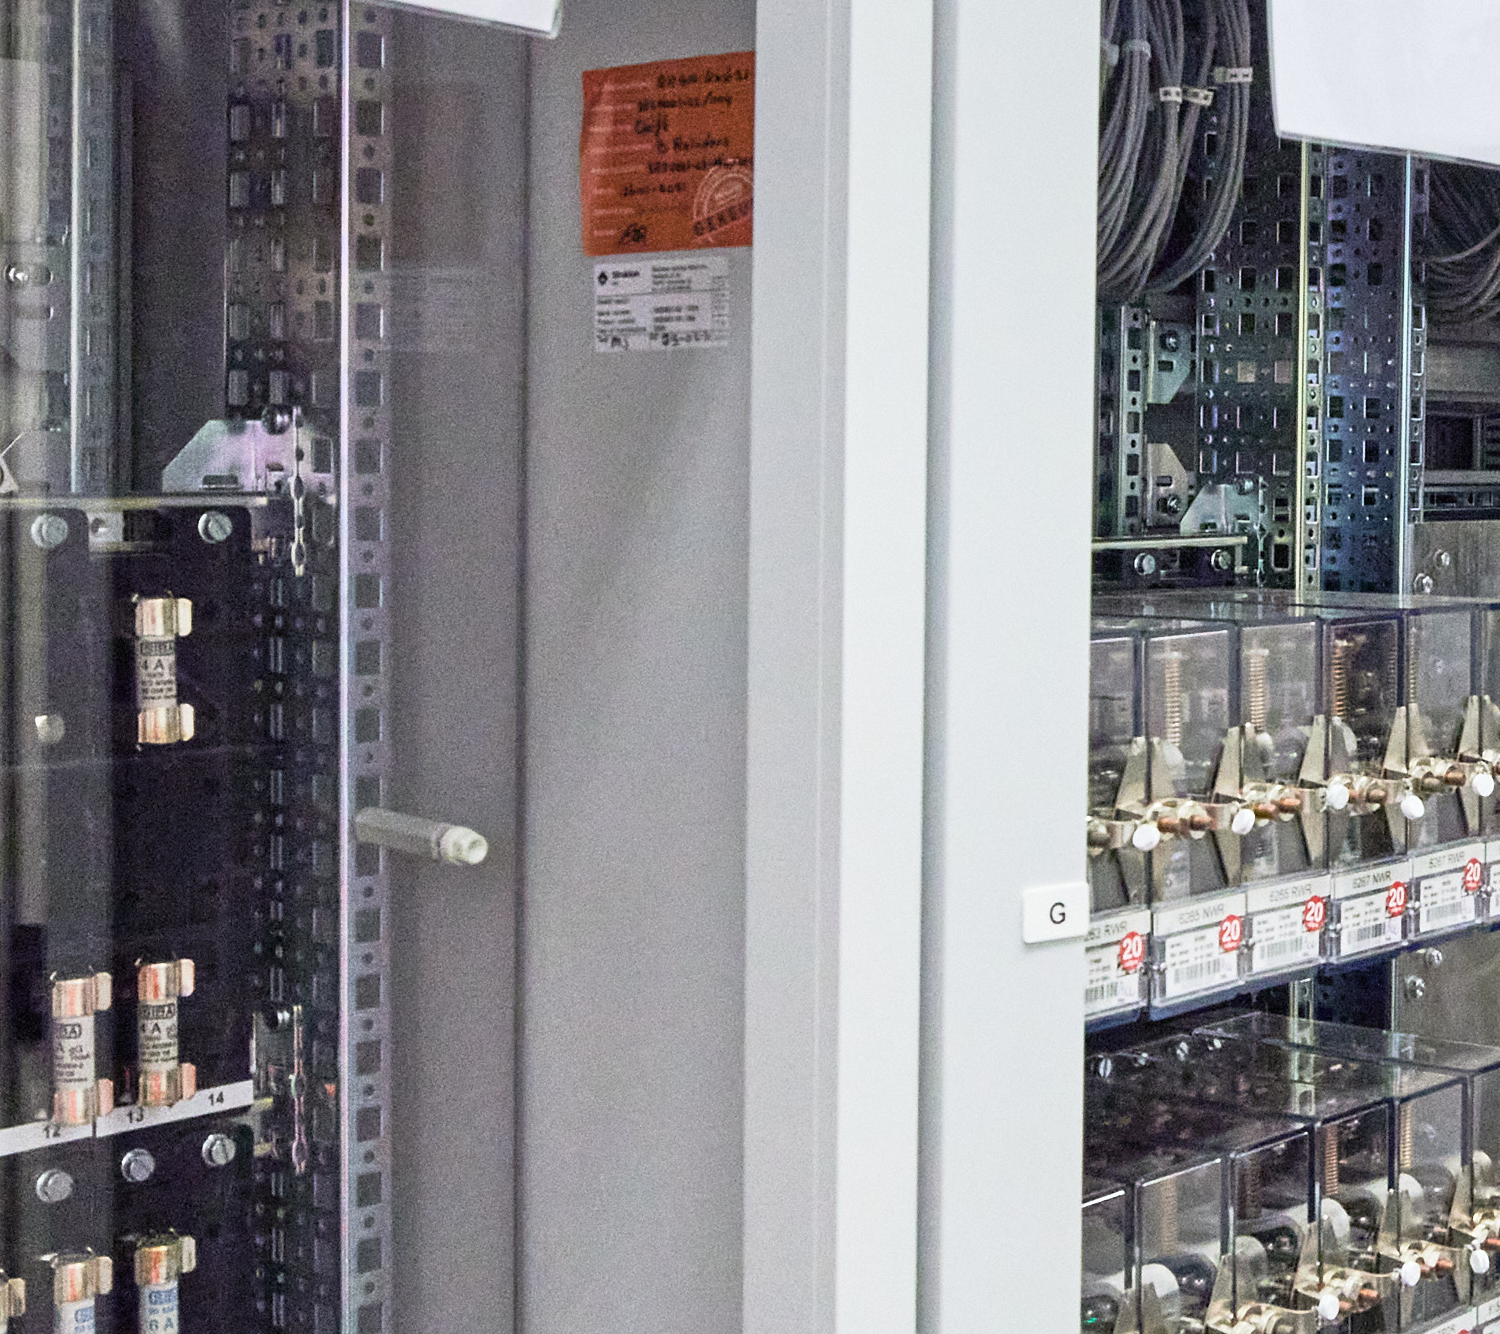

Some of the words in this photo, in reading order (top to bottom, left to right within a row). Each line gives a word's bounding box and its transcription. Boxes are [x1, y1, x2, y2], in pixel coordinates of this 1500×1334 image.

[1464, 864, 1482, 883] 20
[1388, 888, 1407, 908] 20
[1048, 900, 1067, 926] G
[1305, 903, 1325, 922] 20
[1221, 923, 1241, 942] 20
[1121, 940, 1143, 960] 20
[126, 1108, 144, 1124] 13
[207, 1089, 225, 1105] 14
